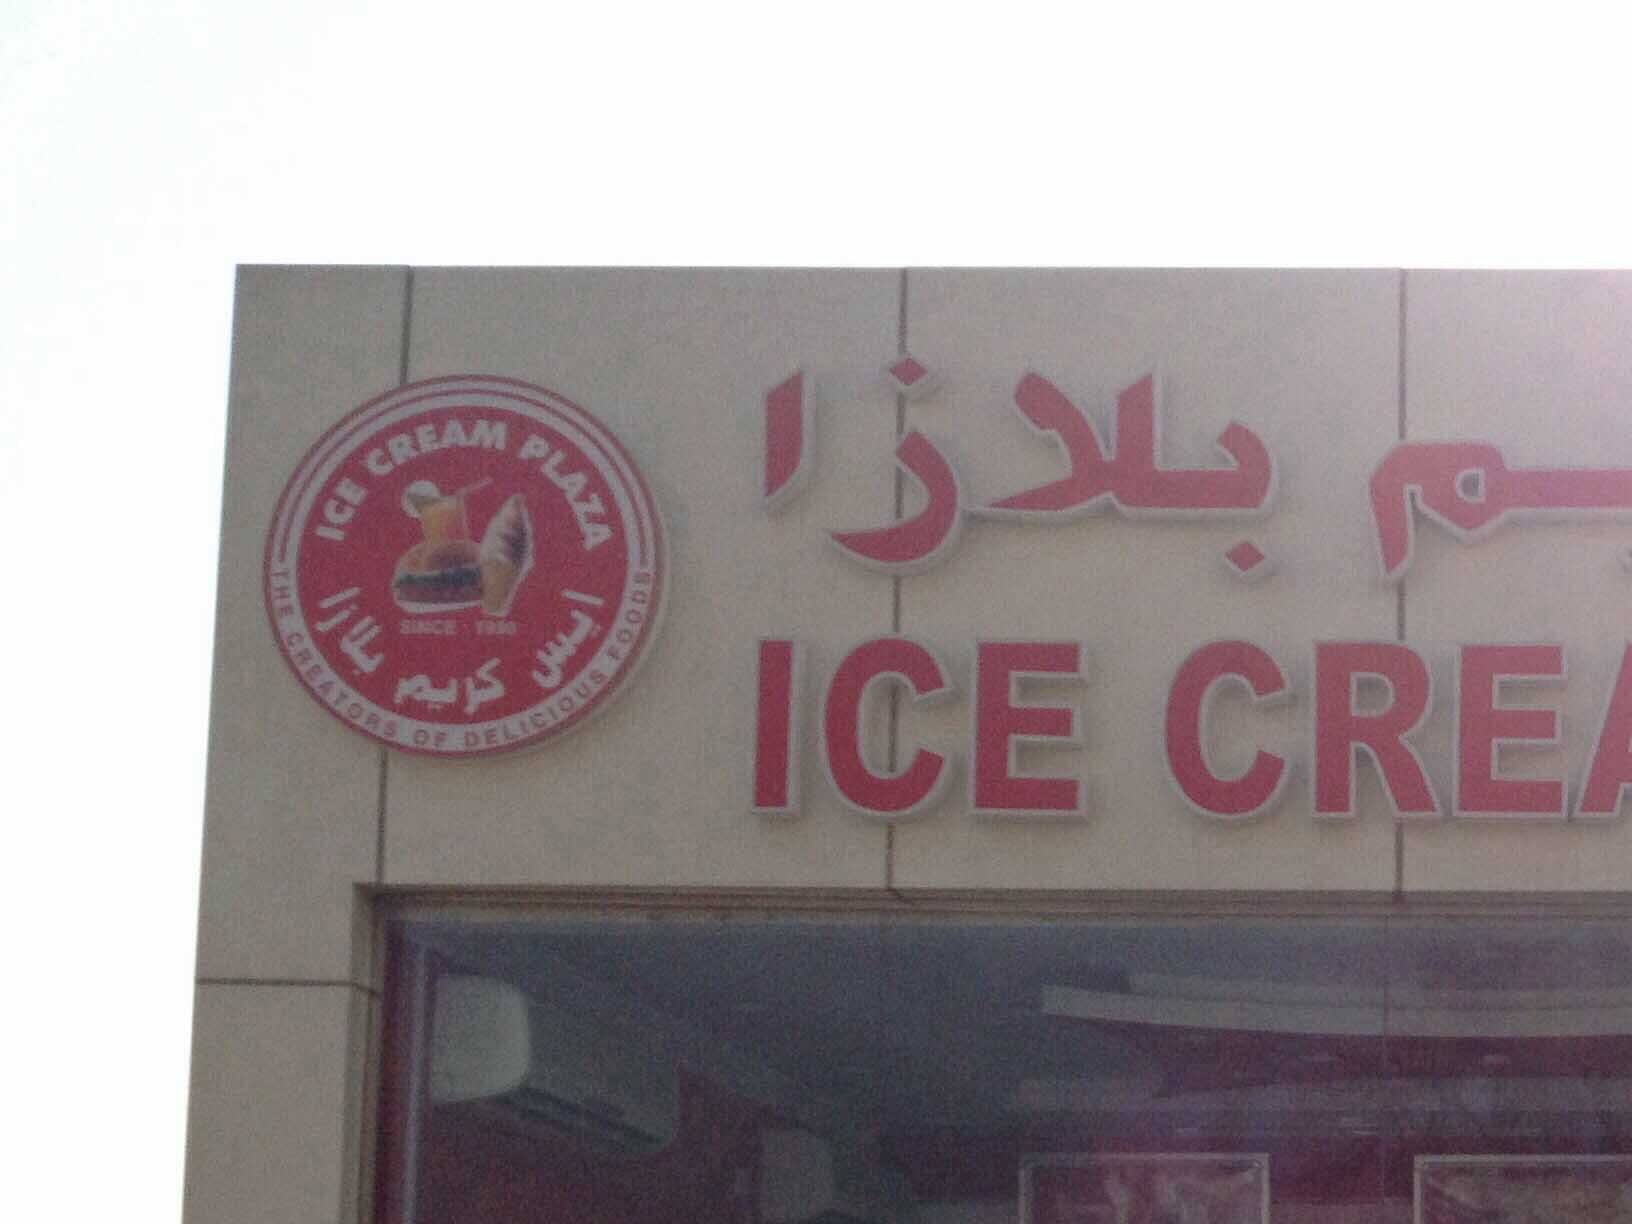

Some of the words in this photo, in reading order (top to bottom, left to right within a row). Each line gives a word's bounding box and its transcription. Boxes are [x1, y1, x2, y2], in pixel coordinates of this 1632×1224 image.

[316, 478, 367, 542] ICE
[364, 418, 507, 476] CREAM
[519, 433, 614, 551] PLAZA
[763, 356, 1273, 574] بلازا
[271, 570, 294, 617] THE
[284, 632, 399, 738] CREATORS
[413, 728, 447, 746] OF
[464, 670, 609, 747] DELICIOUS
[315, 586, 385, 676] بلازا
[394, 658, 506, 716] كريم
[399, 619, 457, 636] SINCE
[753, 637, 1082, 814] ICE
